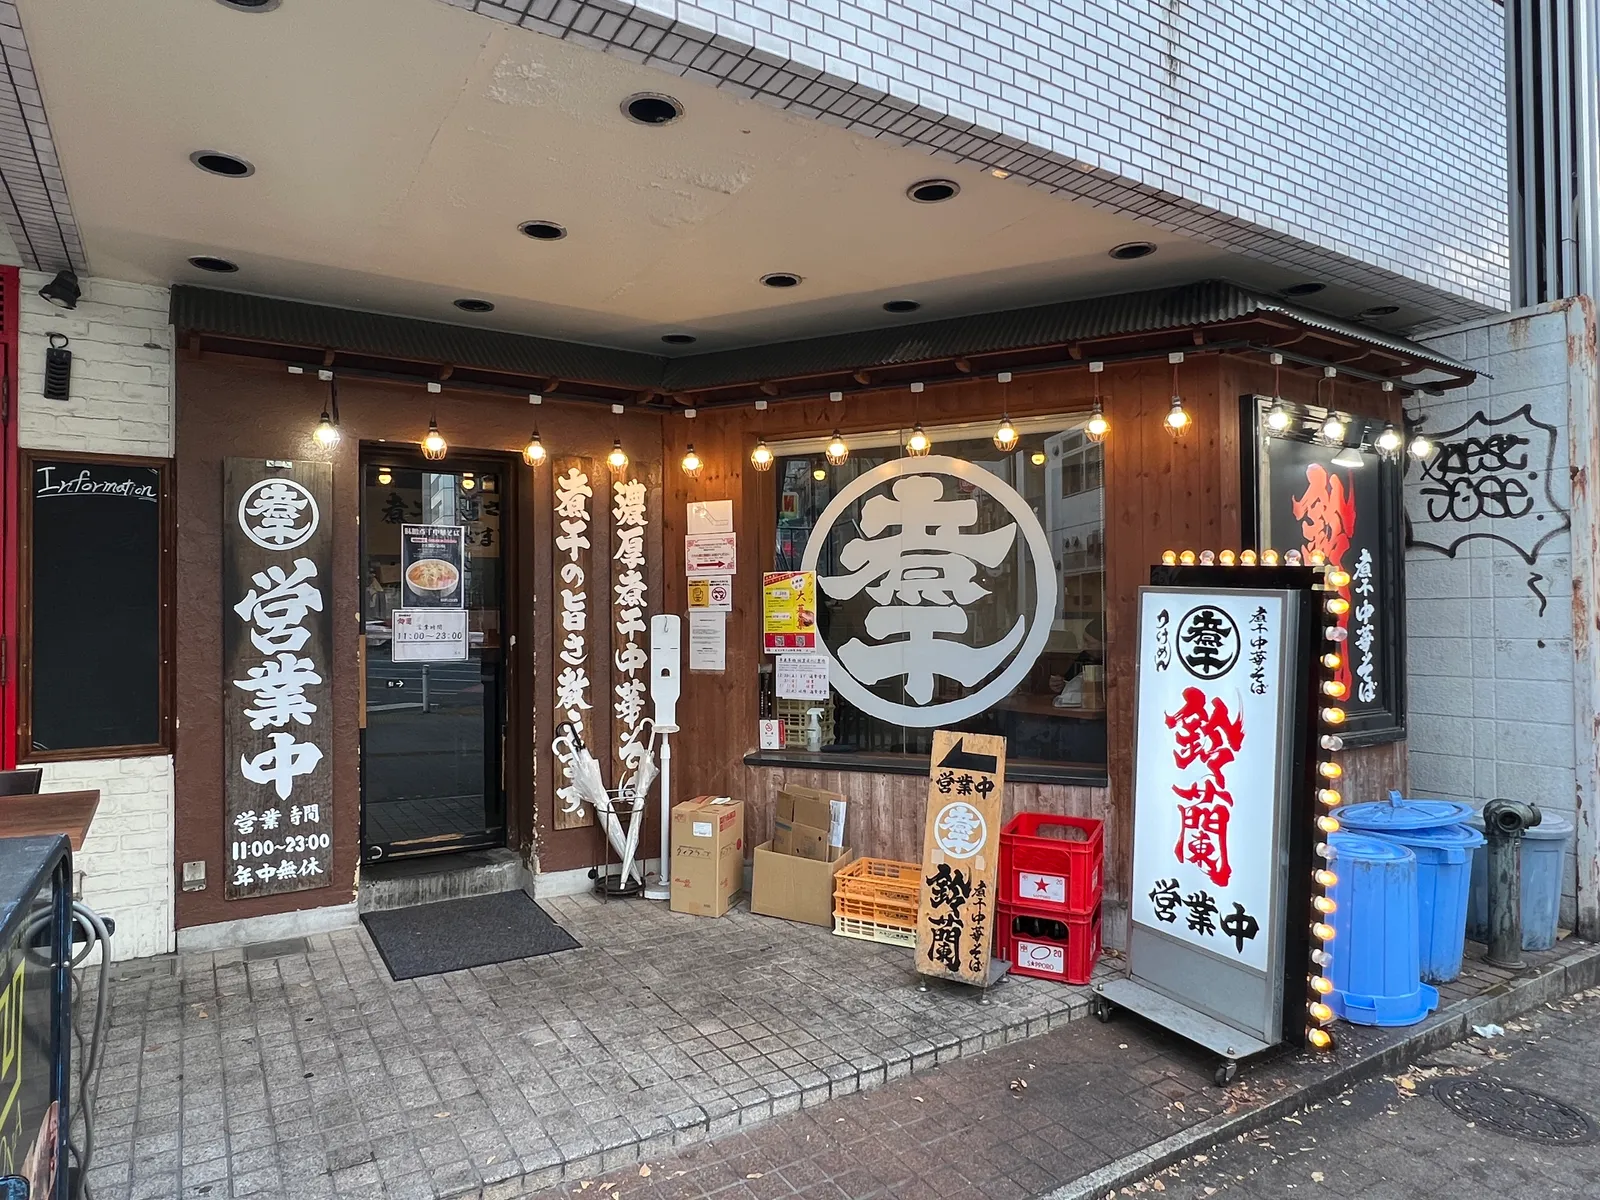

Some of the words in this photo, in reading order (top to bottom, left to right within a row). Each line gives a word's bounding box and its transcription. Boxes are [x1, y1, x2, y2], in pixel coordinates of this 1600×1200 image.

[37, 466, 157, 497] Information
[1291, 462, 1357, 702] 鈴
[1248, 605, 1269, 696] 煮干中華そば
[1352, 547, 1378, 703] 煮干中華そば
[233, 557, 324, 801] 営業中
[935, 770, 995, 800] 営業中
[1164, 686, 1247, 888] 鈴蘭
[232, 856, 324, 887] 年中無休
[1053, 949, 1062, 958] 20
[1148, 877, 1261, 954] 営業中
